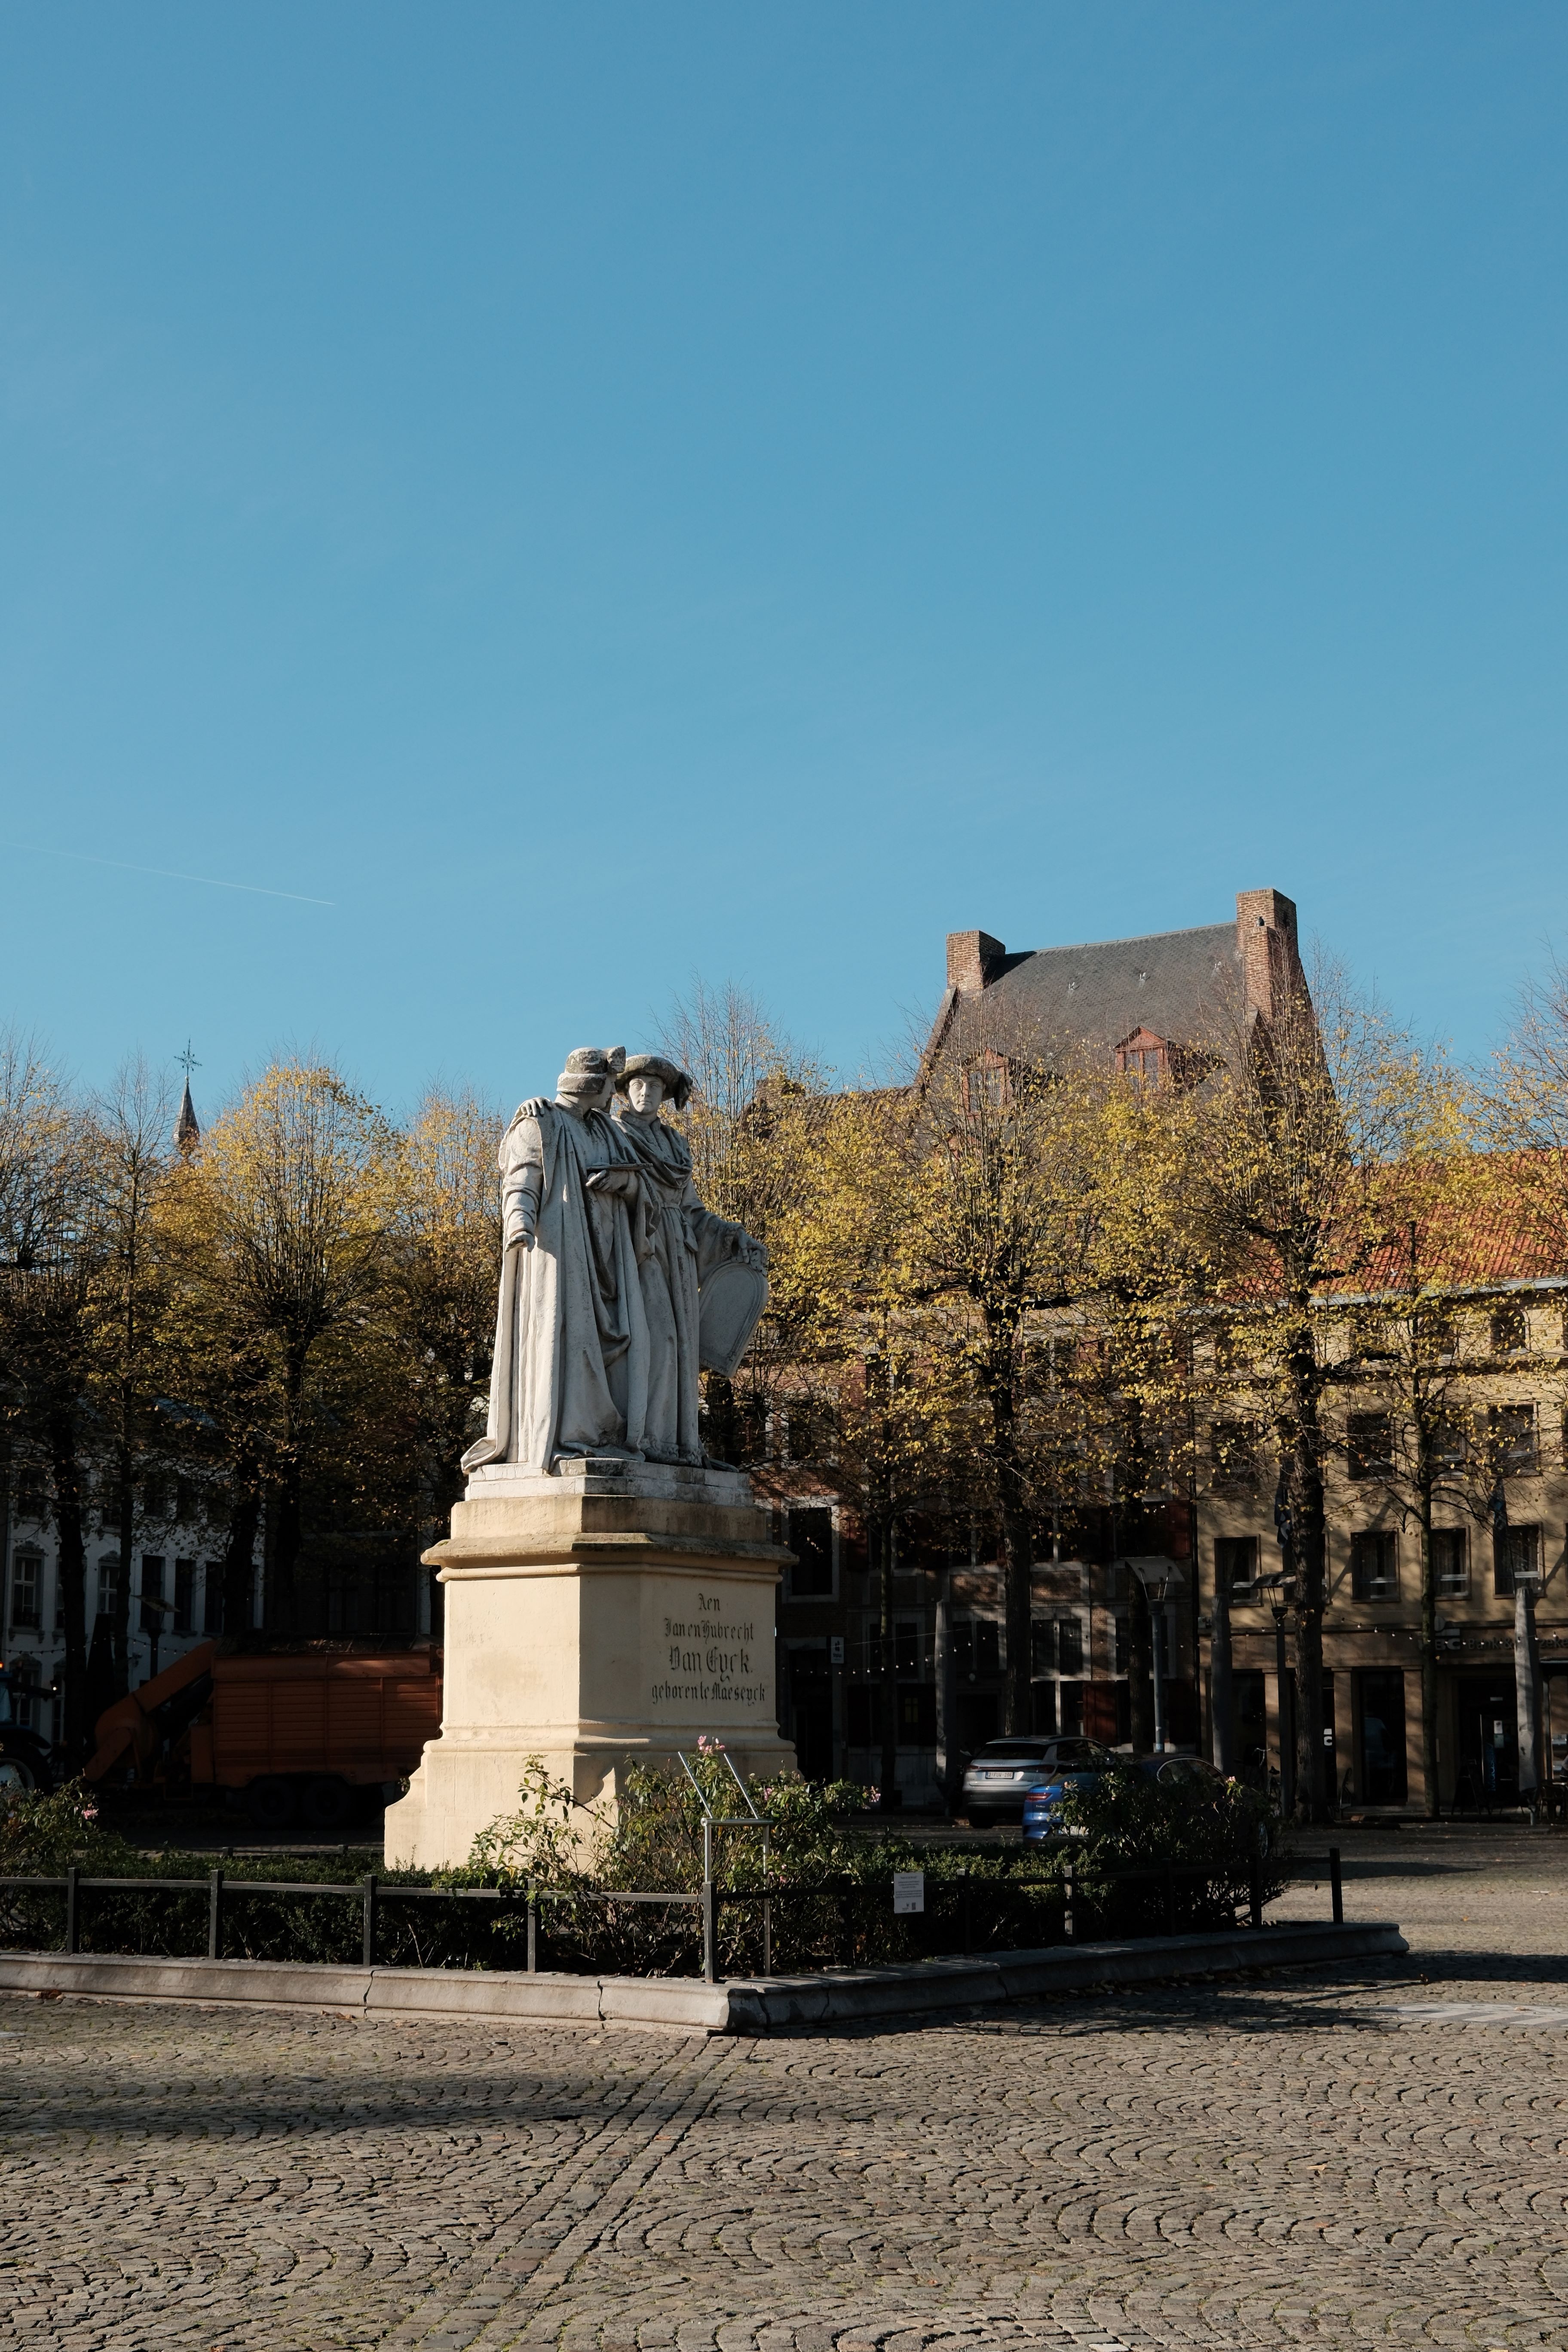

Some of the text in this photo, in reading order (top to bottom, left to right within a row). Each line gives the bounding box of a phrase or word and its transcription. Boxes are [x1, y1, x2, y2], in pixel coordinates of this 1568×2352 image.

[698, 1592, 720, 1611] Aen
[664, 1617, 753, 1645] Jan en Hubrecht
[1468, 1636, 1500, 1649] Bank
[1504, 1637, 1513, 1649] &
[669, 1645, 701, 1673] Van
[652, 1680, 698, 1704] geboren
[711, 1682, 765, 1706] Maeseyck
